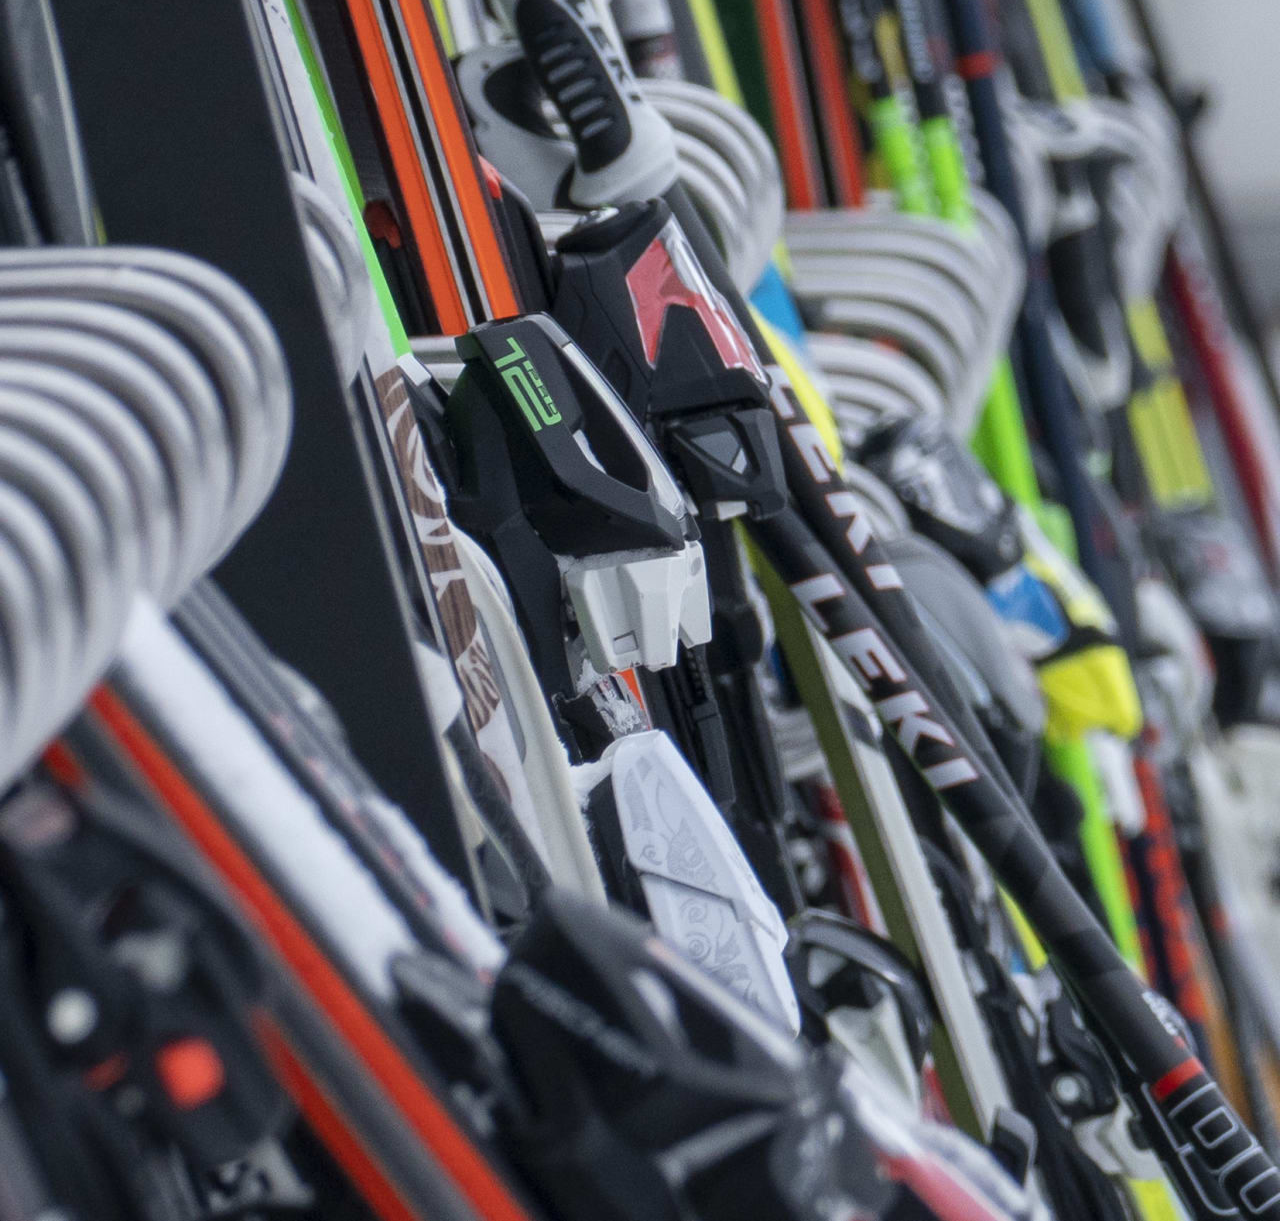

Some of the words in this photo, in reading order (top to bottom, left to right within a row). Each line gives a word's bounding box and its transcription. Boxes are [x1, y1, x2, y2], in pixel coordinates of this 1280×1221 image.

[494, 337, 562, 432] 12
[763, 364, 903, 590] LEKI
[789, 573, 979, 790] LEKI
